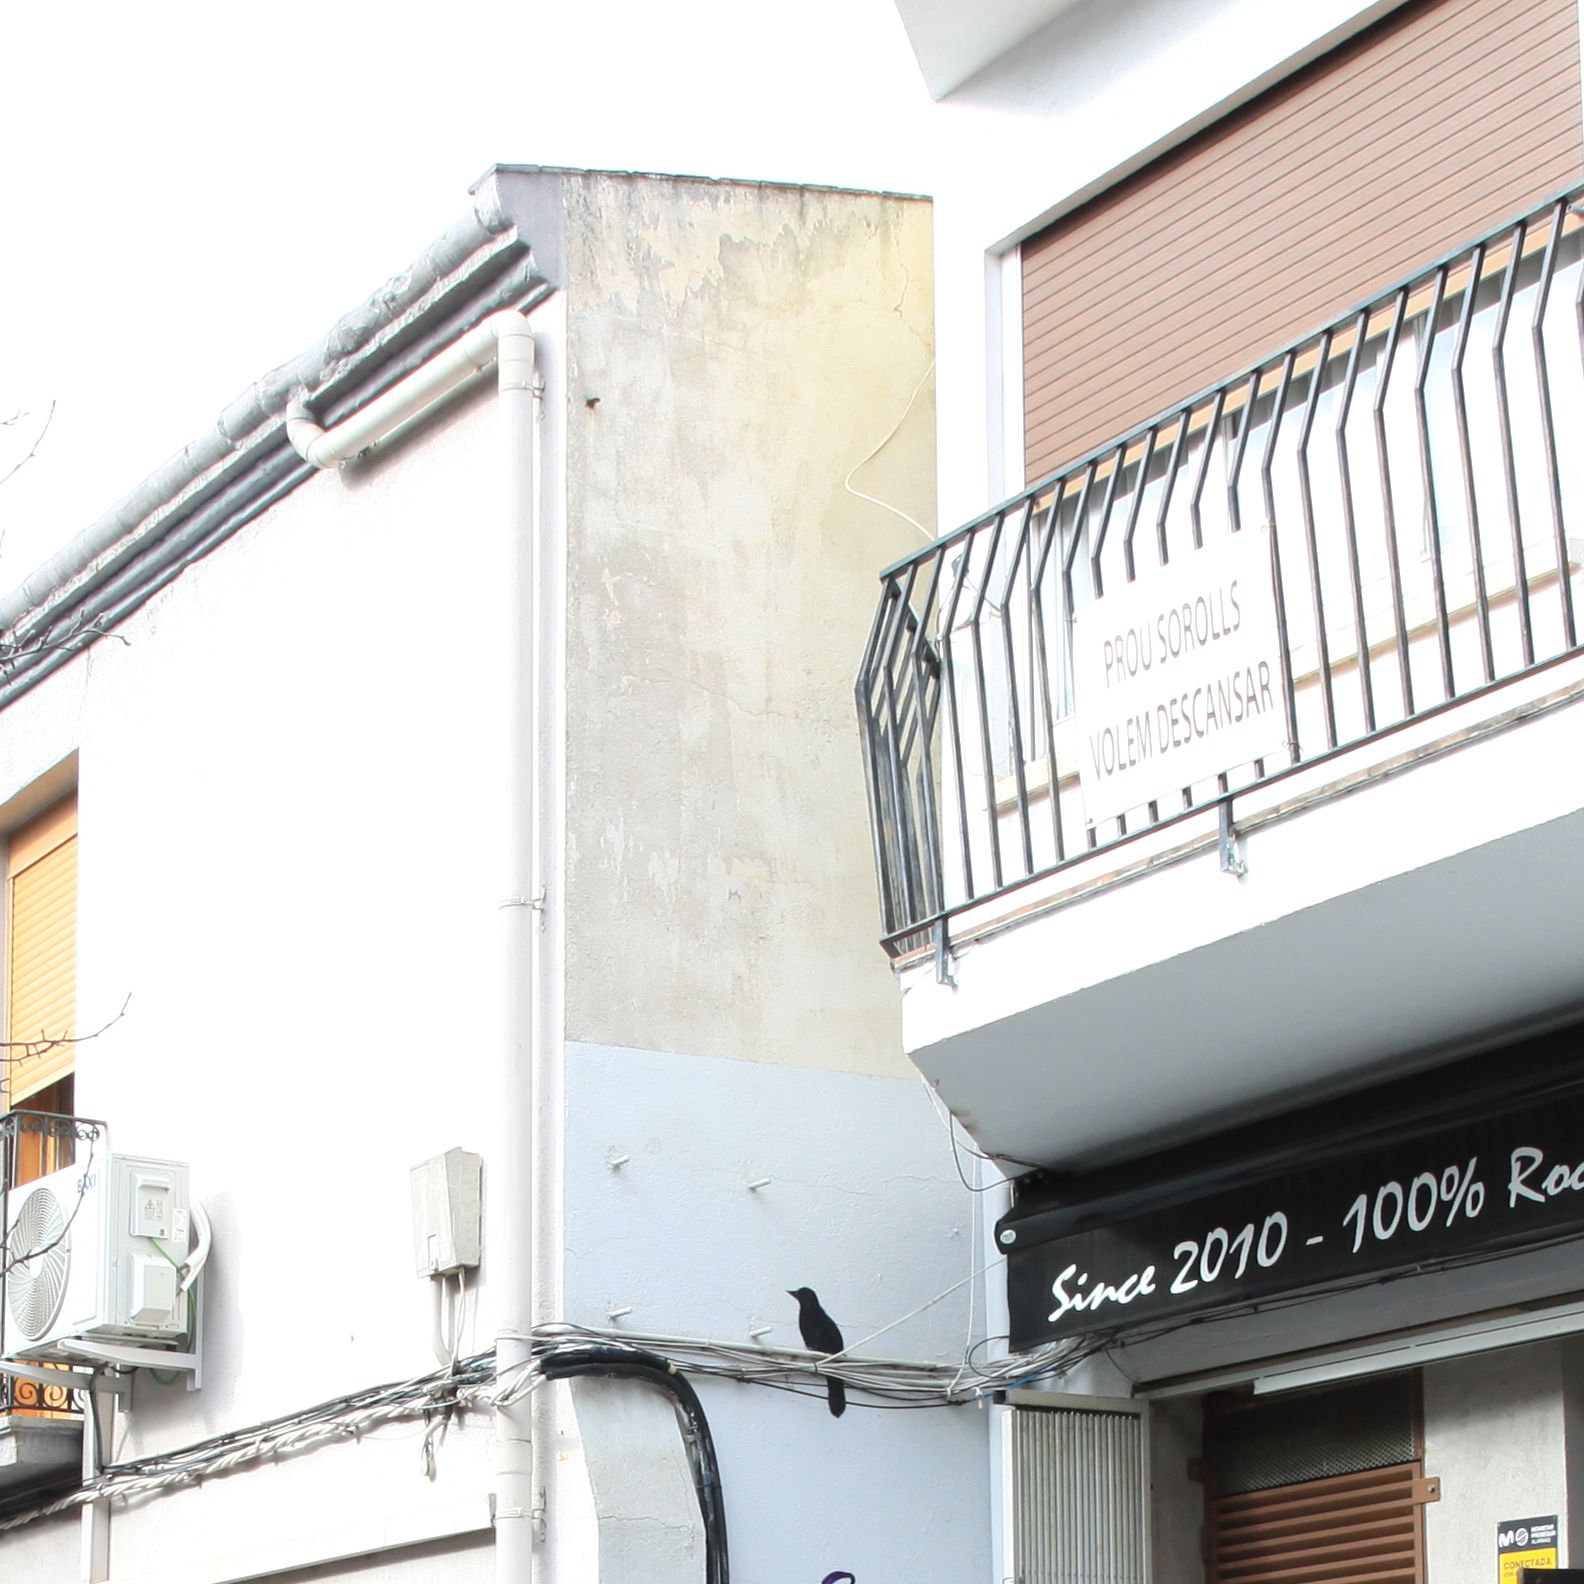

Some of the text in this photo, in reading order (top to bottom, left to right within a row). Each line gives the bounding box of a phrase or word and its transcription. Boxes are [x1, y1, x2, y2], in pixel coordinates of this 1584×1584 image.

[1102, 580, 1241, 688] PROU SOROLLS
[1089, 660, 1274, 782] VOLEM DESCANSAR
[1047, 1262, 1158, 1323] Since
[1170, 1210, 1288, 1295] 2010
[1344, 1156, 1486, 1255] 100%
